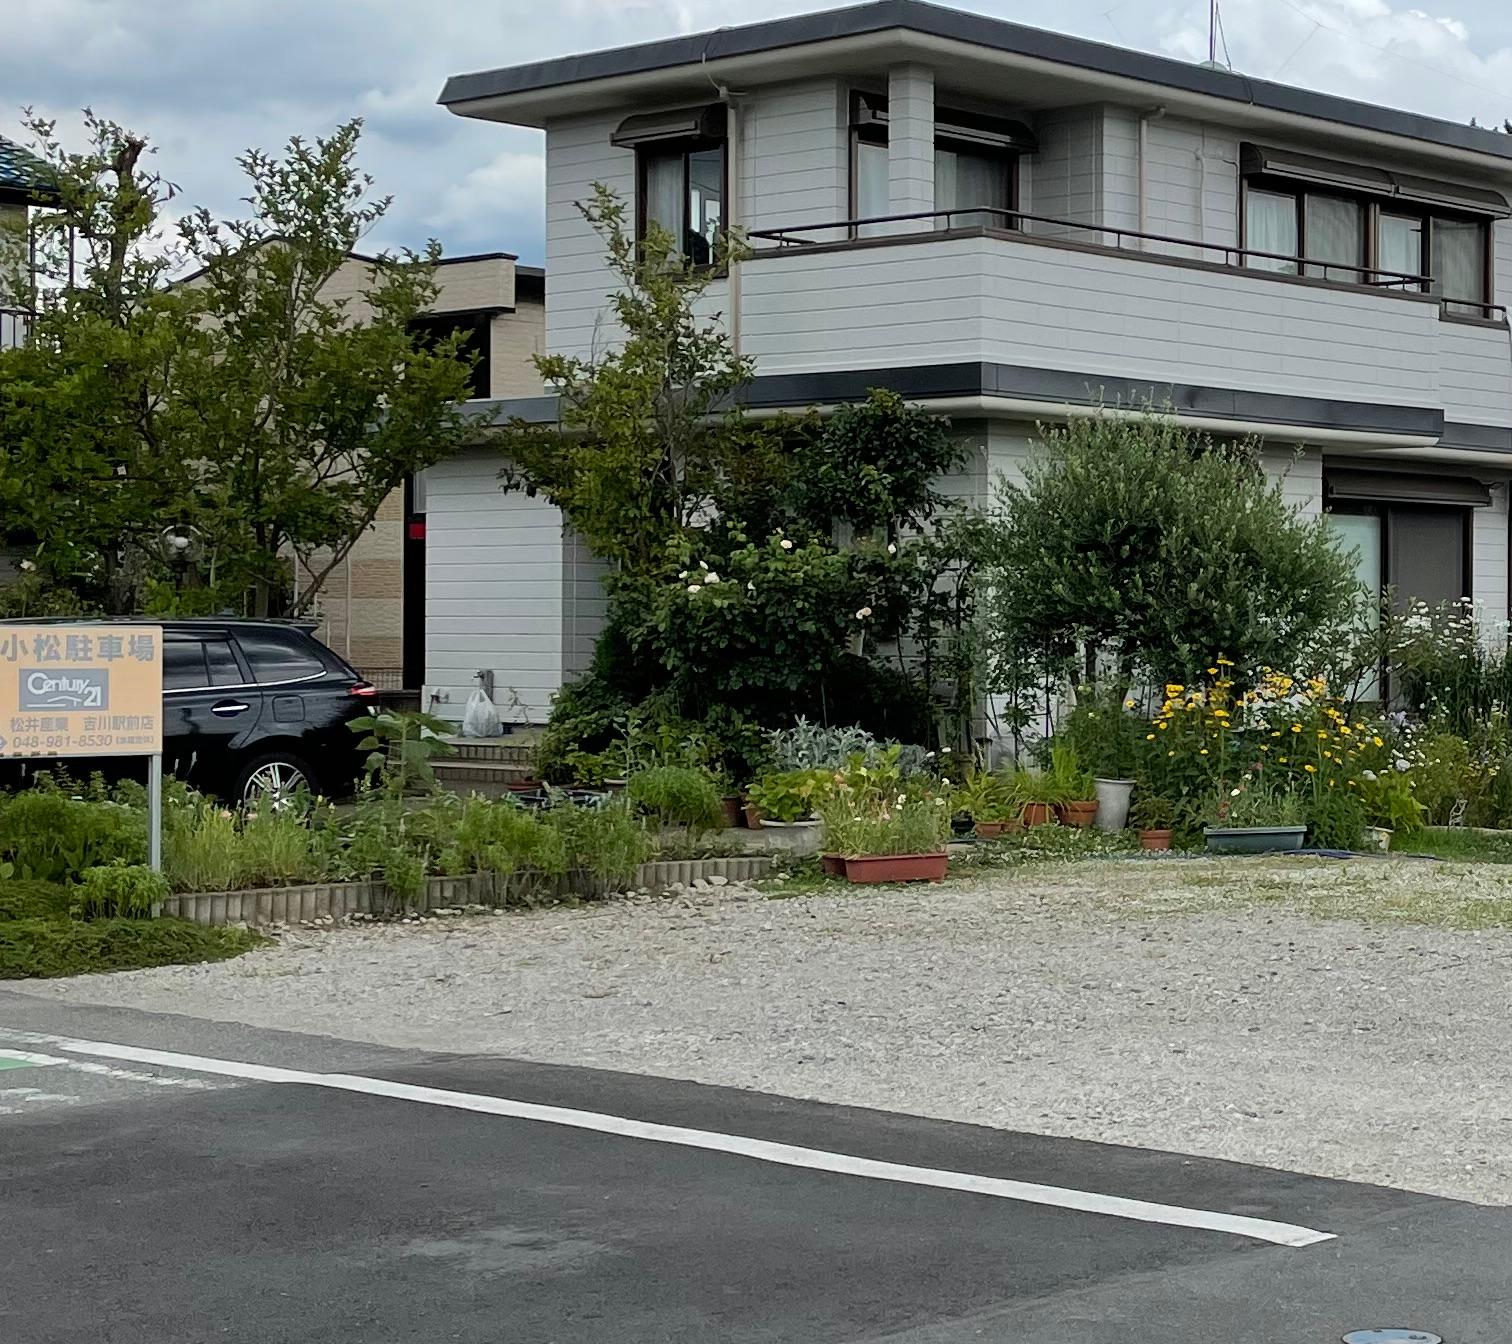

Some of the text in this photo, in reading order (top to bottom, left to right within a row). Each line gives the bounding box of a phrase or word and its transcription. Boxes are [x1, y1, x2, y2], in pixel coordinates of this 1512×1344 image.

[0, 634, 155, 662] 小松駐車場
[84, 716, 154, 731] 吉川駅前店
